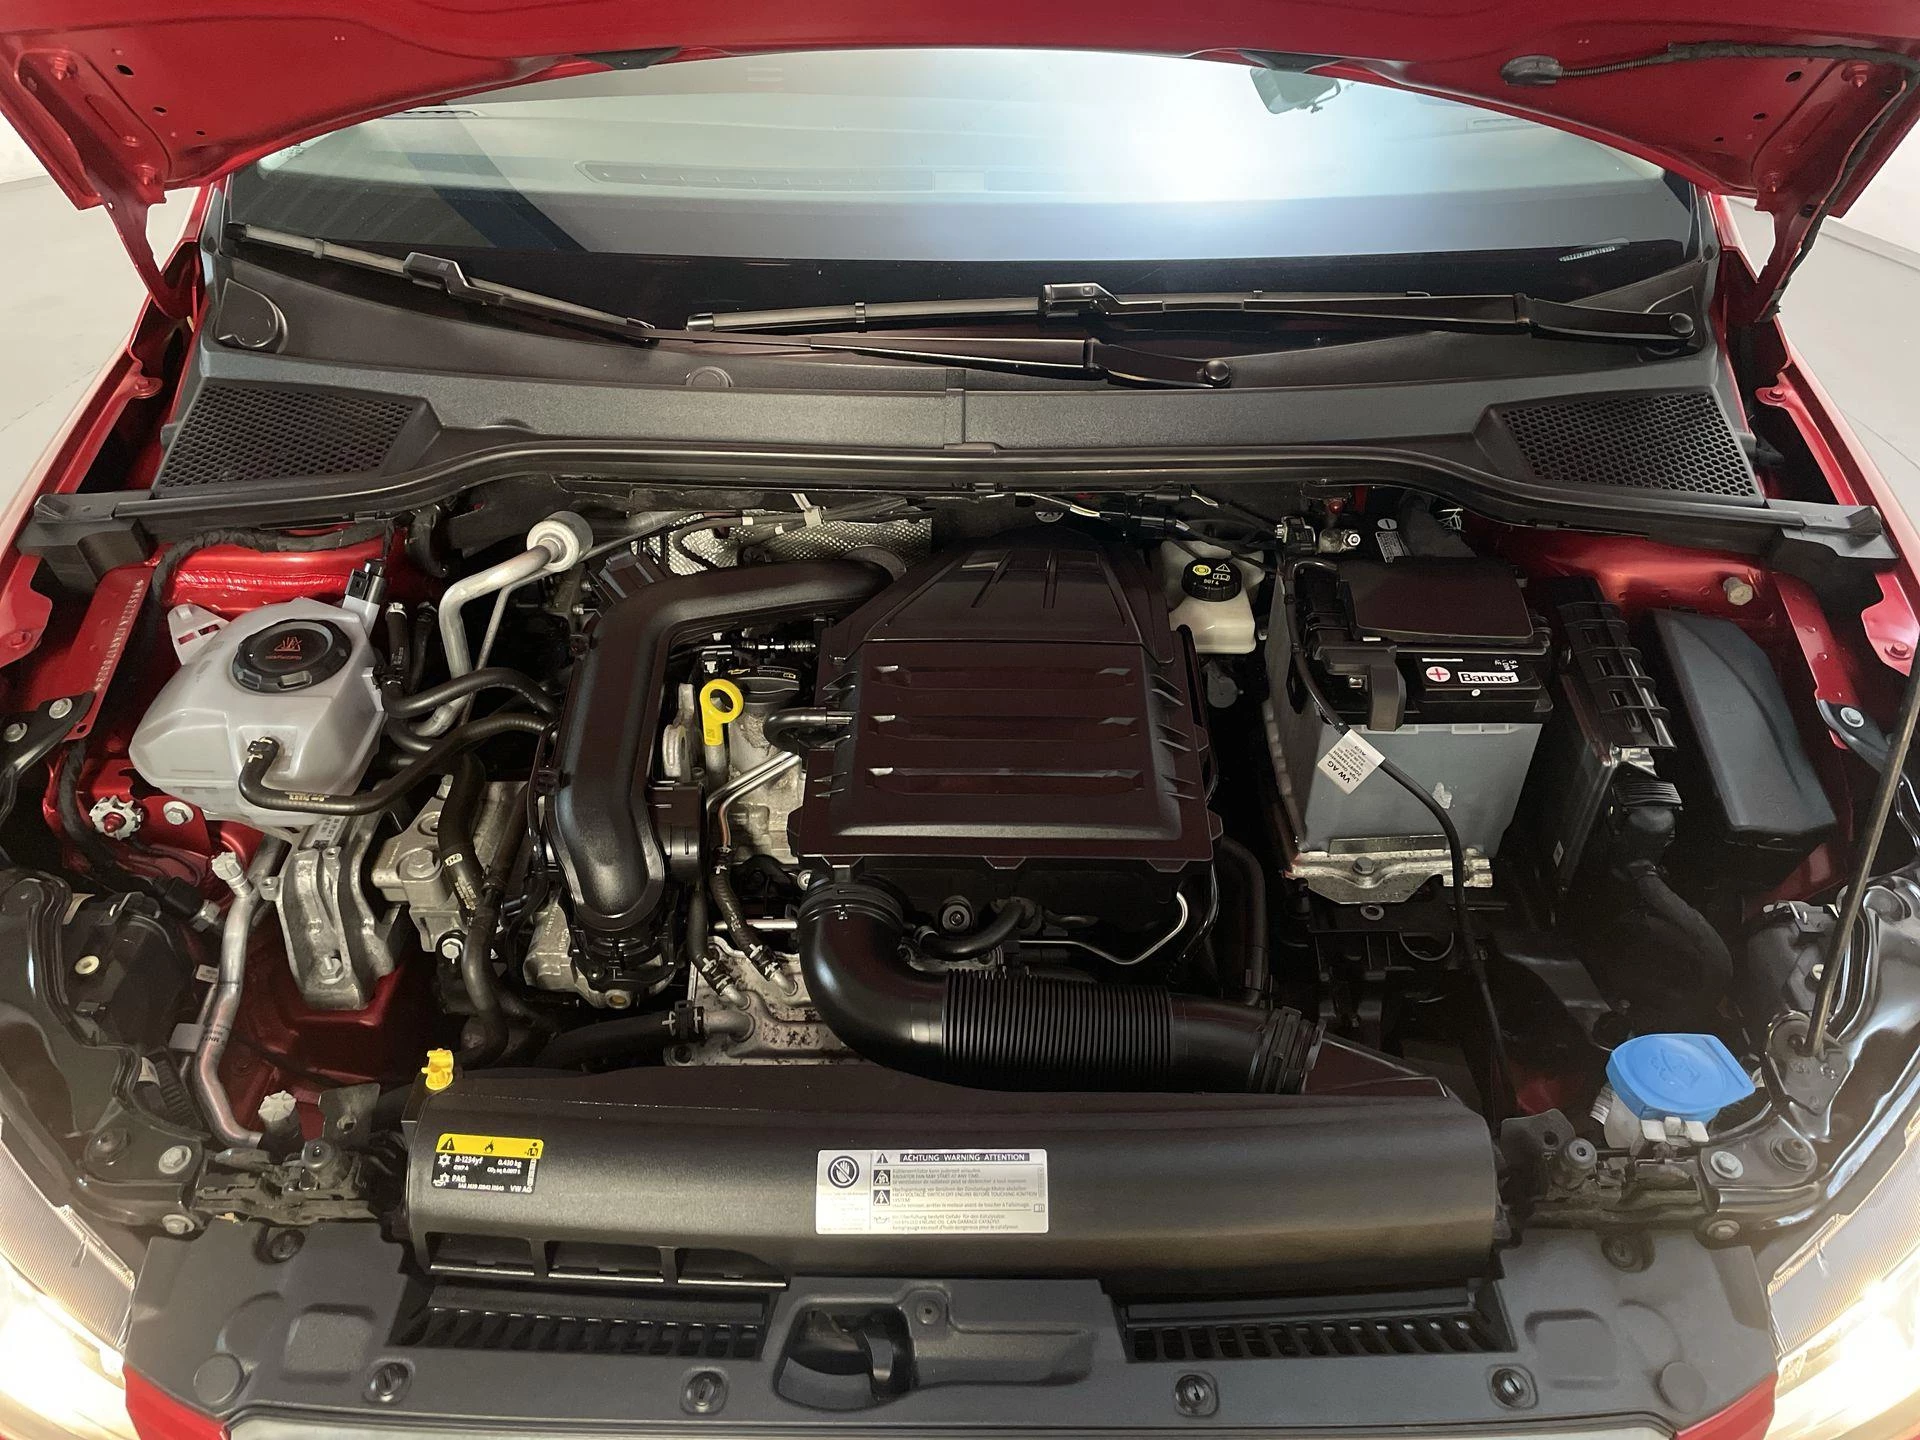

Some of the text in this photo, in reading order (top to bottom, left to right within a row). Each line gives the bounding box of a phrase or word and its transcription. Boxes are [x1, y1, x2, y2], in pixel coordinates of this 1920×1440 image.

[1460, 673, 1514, 682] Banner
[1327, 760, 1340, 772] AG
[1338, 771, 1351, 784] VW
[455, 1155, 483, 1166] R-1234yf
[944, 1153, 981, 1161] WARNING
[984, 1153, 1025, 1161] ATTENTION
[452, 1174, 467, 1182] PAG
[510, 1184, 521, 1192] VW
